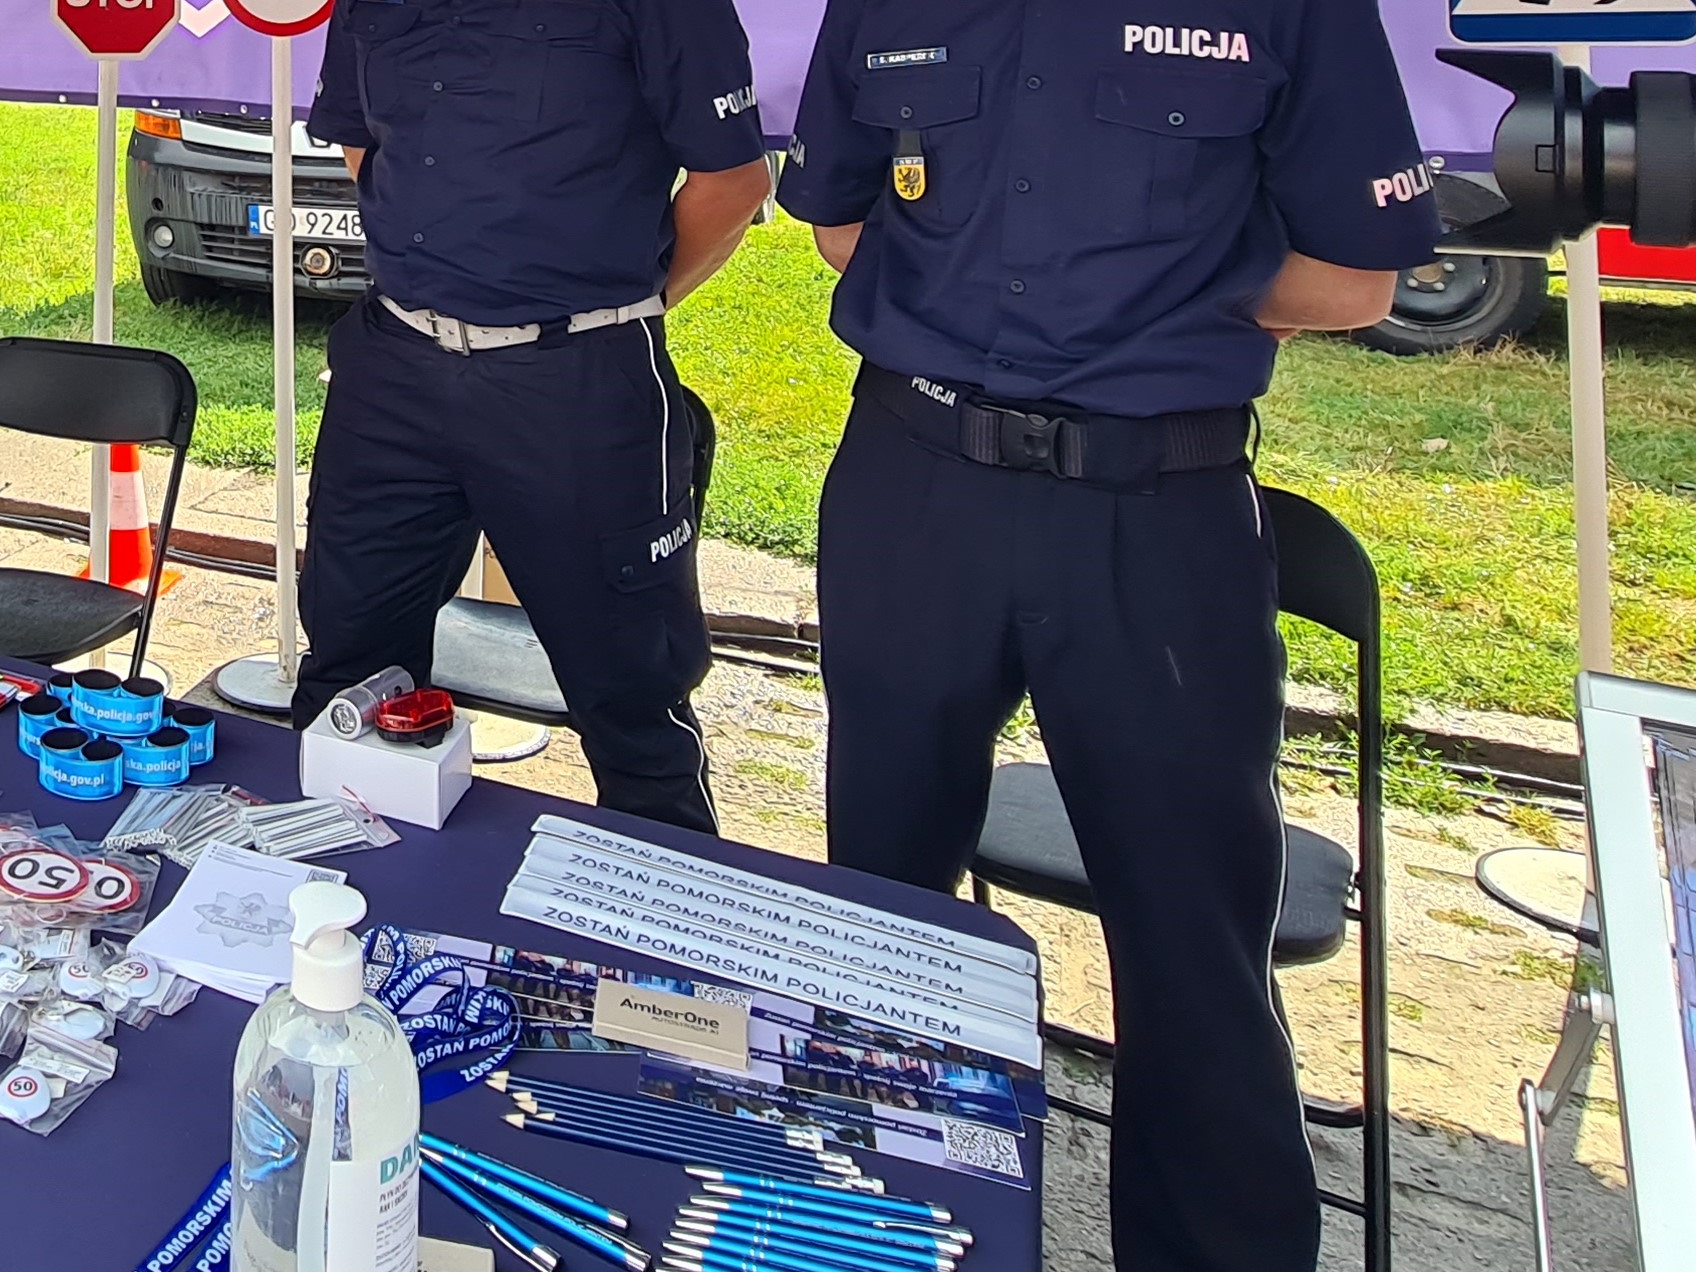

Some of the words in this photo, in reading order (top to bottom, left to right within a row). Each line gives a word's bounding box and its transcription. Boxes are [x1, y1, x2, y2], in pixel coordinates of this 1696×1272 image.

[1124, 24, 1251, 63] POLICJA
[1372, 162, 1434, 208] POLI
[306, 211, 363, 237] 9248
[911, 376, 957, 407] POLICJA
[650, 518, 693, 563] POLICJA
[7, 857, 76, 890] 50
[211, 916, 269, 935] POLICJA
[568, 854, 651, 884] ZOSTAŃ
[656, 878, 791, 924] POMORSKIM
[798, 919, 963, 973] POLICJANTEM
[561, 872, 645, 902] ZOSTAŃ
[651, 897, 789, 943] POMORSKIM
[795, 938, 963, 994] POLICJANTEM
[542, 906, 631, 940] ZOSTAŃ
[636, 934, 779, 984] POMORSKIM
[786, 977, 961, 1036] POLICJANTEM
[620, 998, 720, 1029] AmberOne
[417, 1036, 465, 1069] OSTAŃ
[13, 1081, 33, 1092] 50
